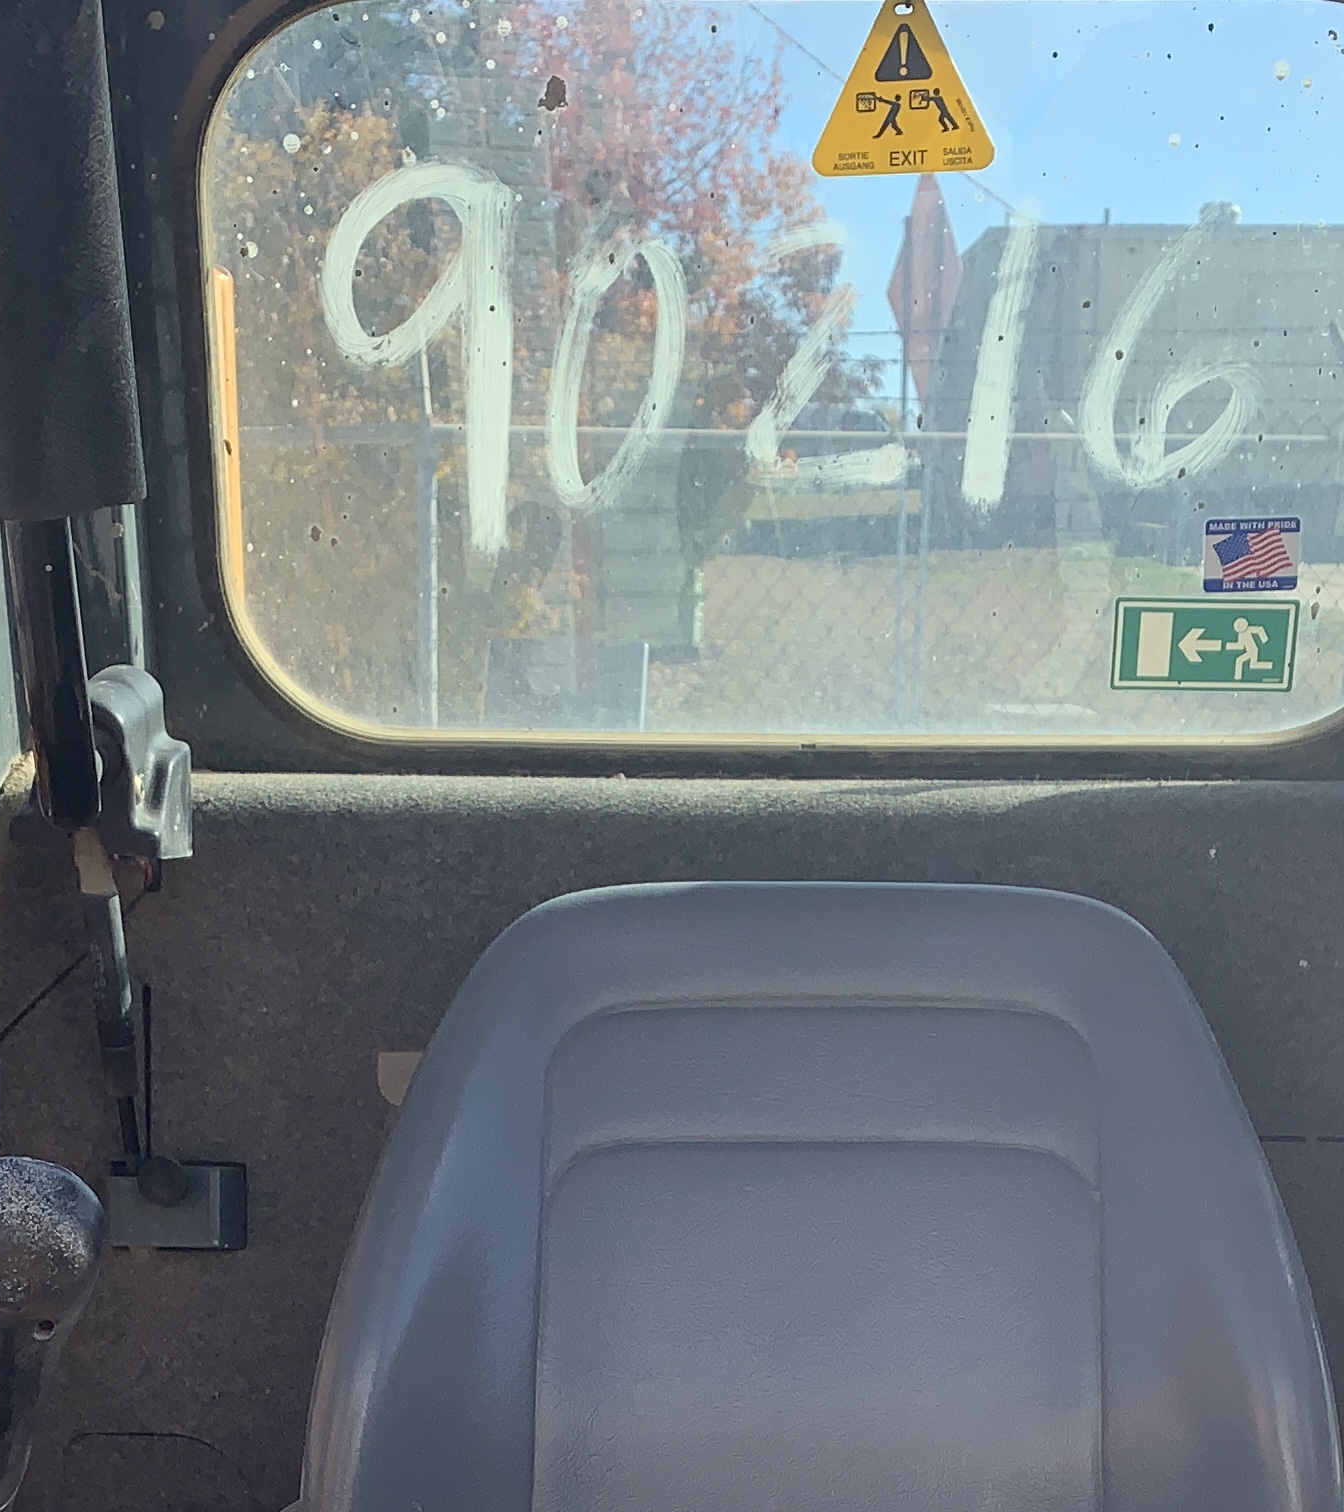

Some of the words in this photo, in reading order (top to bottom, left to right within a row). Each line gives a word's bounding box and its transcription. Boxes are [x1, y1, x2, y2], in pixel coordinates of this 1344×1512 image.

[942, 147, 972, 155] SALIDA
[838, 152, 869, 160] SORTIE
[889, 150, 928, 166] EXIT
[943, 157, 973, 165] USCITA
[833, 162, 874, 171] AUSGANG
[319, 159, 1259, 556] 90216
[1240, 521, 1265, 529] WITH
[1268, 520, 1297, 529] PRIDE
[1258, 580, 1279, 588] USA
